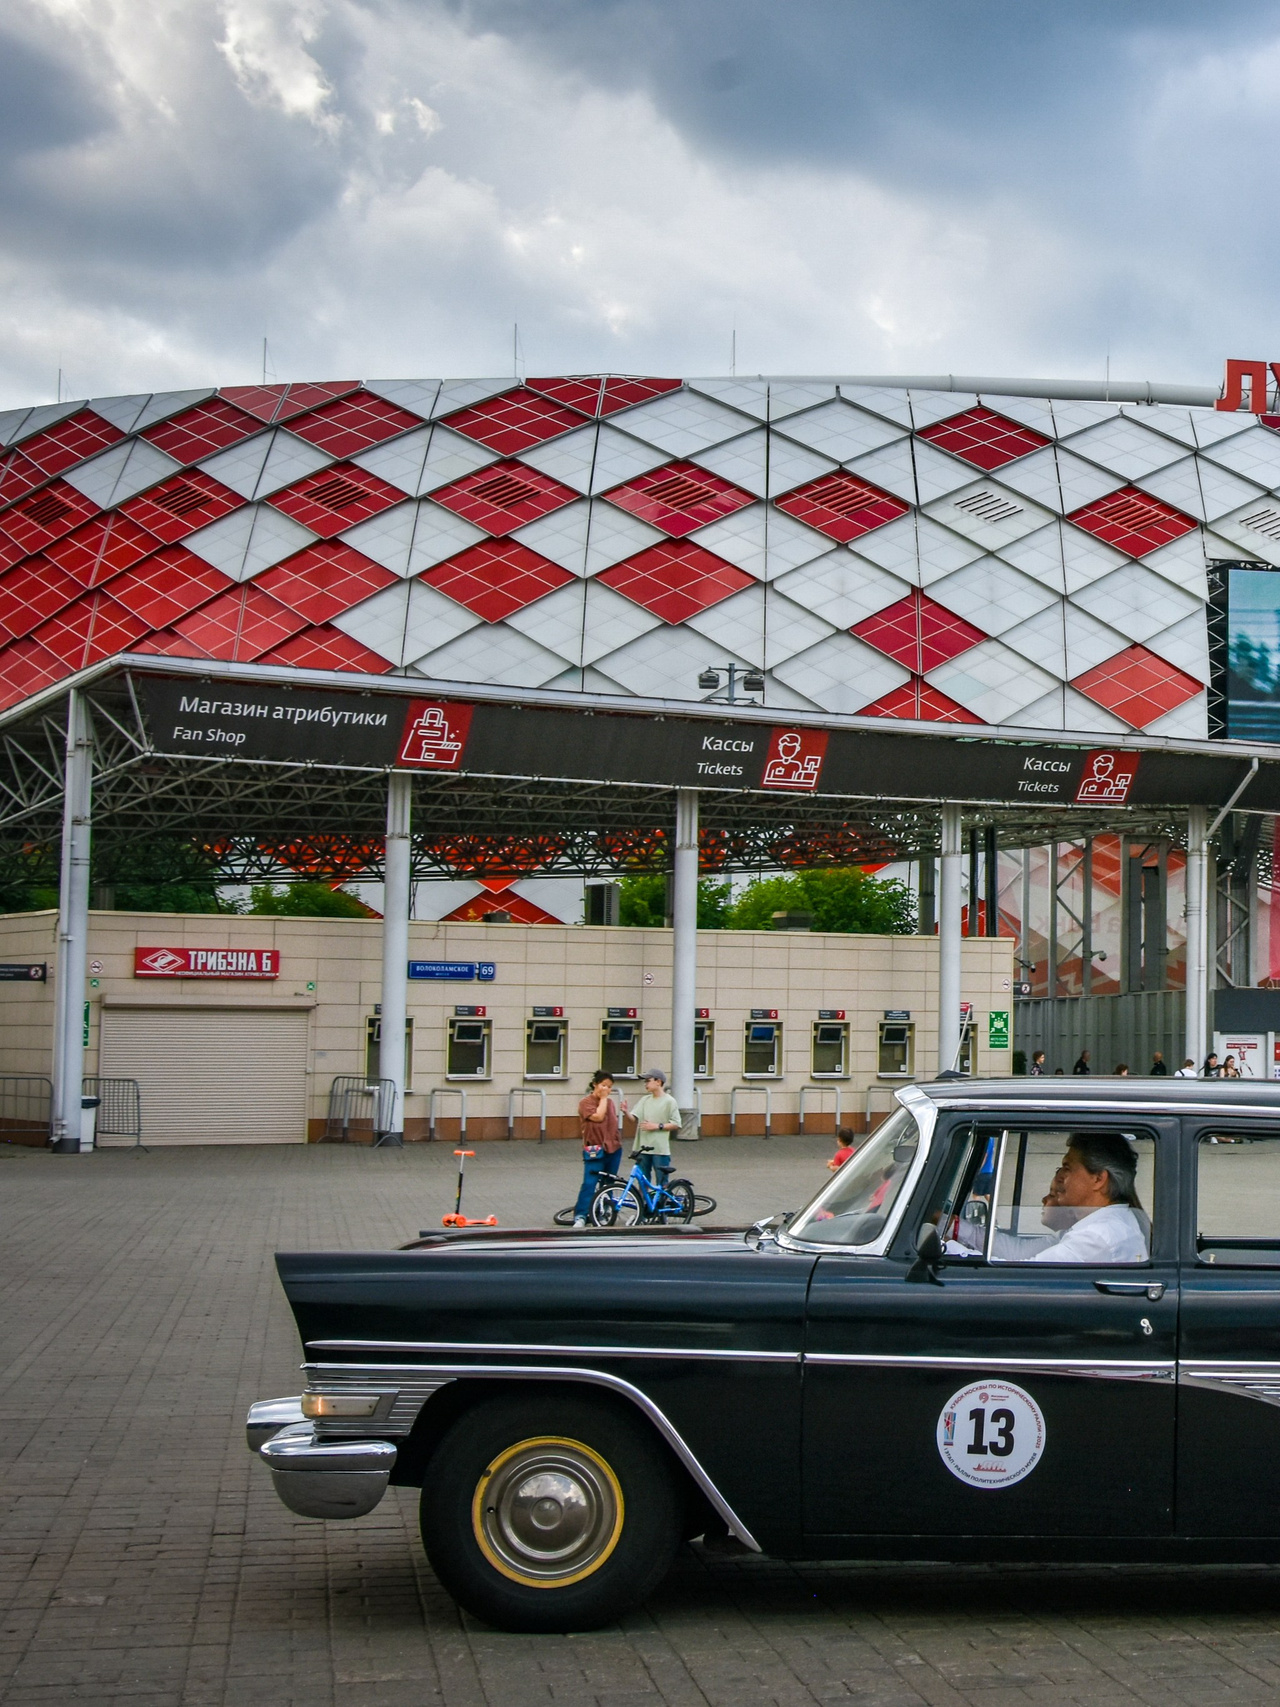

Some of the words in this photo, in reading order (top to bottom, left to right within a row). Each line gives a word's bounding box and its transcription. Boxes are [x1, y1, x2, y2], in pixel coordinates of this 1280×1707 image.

[179, 696, 268, 718] Магазин
[272, 706, 388, 727] атрибутики
[172, 726, 202, 741] Fan
[205, 728, 246, 746] Shop
[702, 736, 754, 752] Кассы
[697, 762, 743, 775] Tickets
[1023, 757, 1071, 772] Кассы
[1018, 781, 1059, 793] Tickets
[188, 951, 257, 971] ТРИБУНА
[416, 965, 469, 973] ВОЛОКОЛАМСКОЕ
[481, 966, 494, 975] 69
[950, 1394, 964, 1410] КУБОК
[964, 1384, 987, 1396] МОСКВЫ
[998, 1384, 1037, 1413] ИСТОРИЧЕСКОМУ
[1034, 1413, 1042, 1433] РАЛЛИ
[967, 1408, 1015, 1457] 13
[954, 1464, 970, 1478] РАЛЛИ
